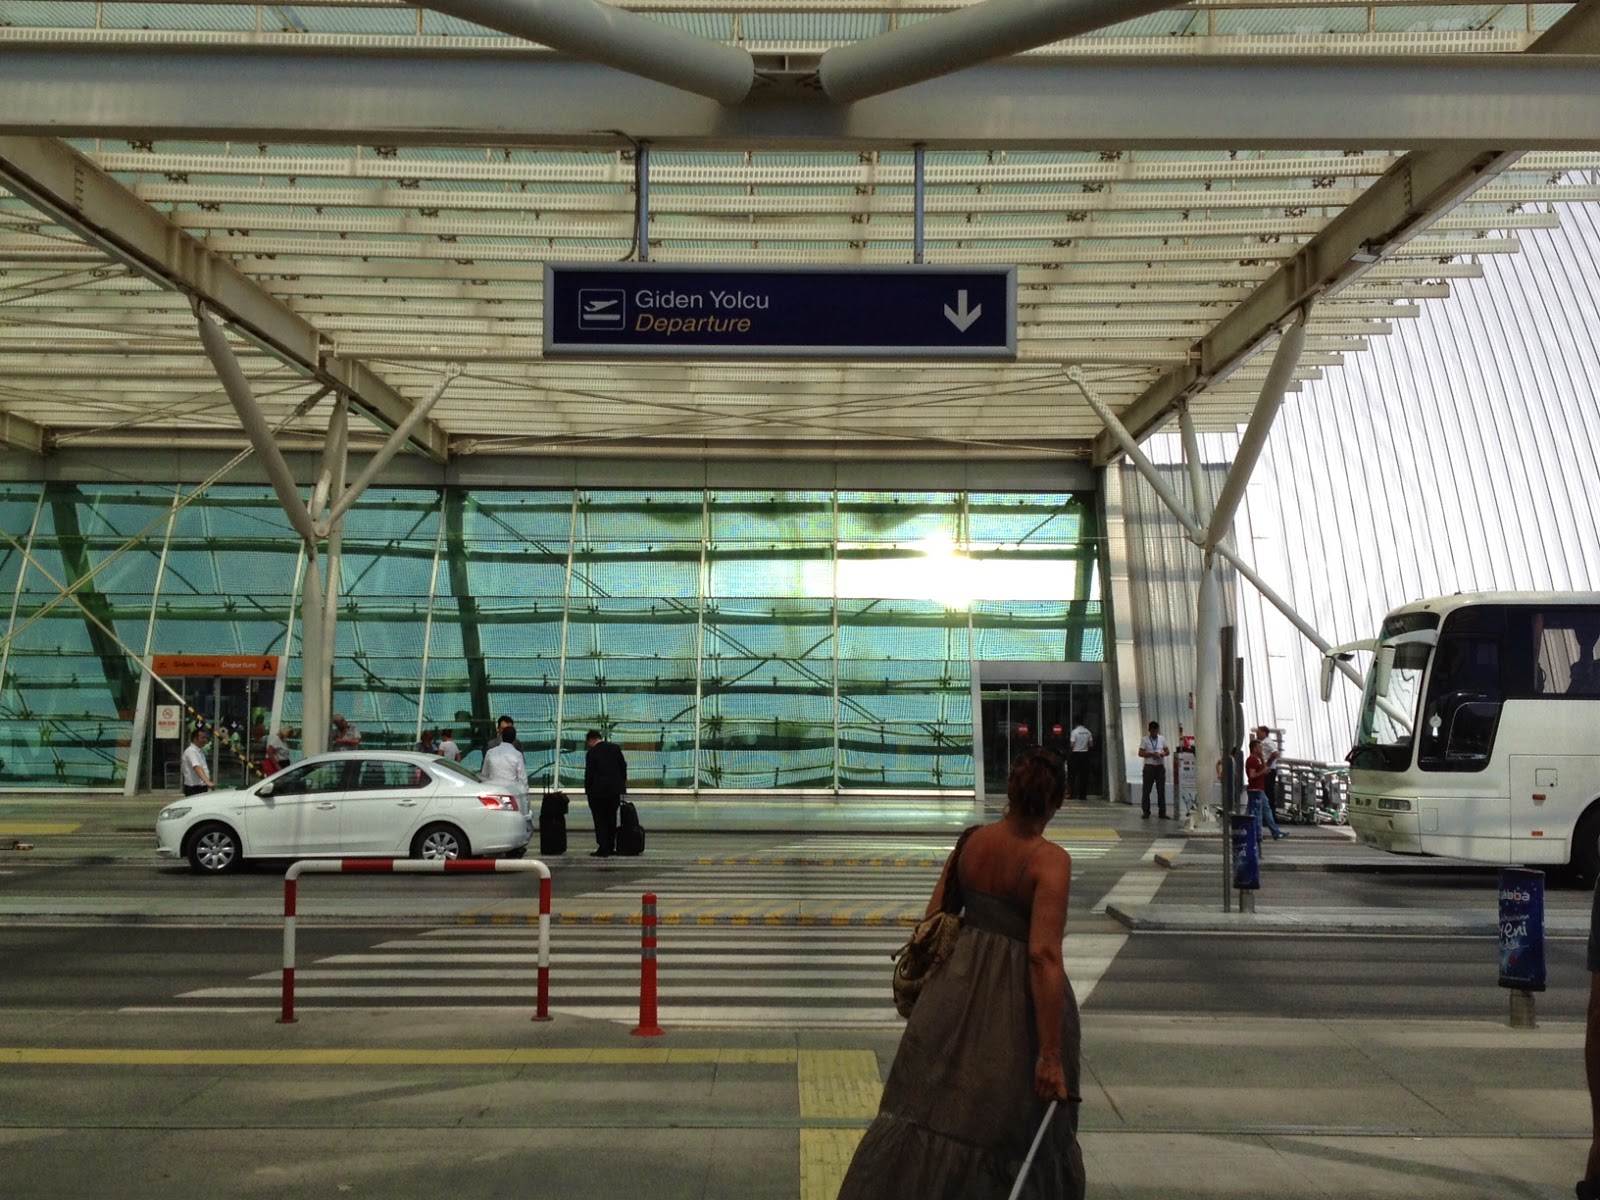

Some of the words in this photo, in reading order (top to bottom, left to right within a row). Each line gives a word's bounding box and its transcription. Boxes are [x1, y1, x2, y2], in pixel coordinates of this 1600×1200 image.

[635, 289, 702, 309] Giden
[709, 289, 769, 309] Yolcu
[635, 314, 751, 335] Departure
[221, 661, 257, 669] Departure
[262, 659, 273, 671] A
